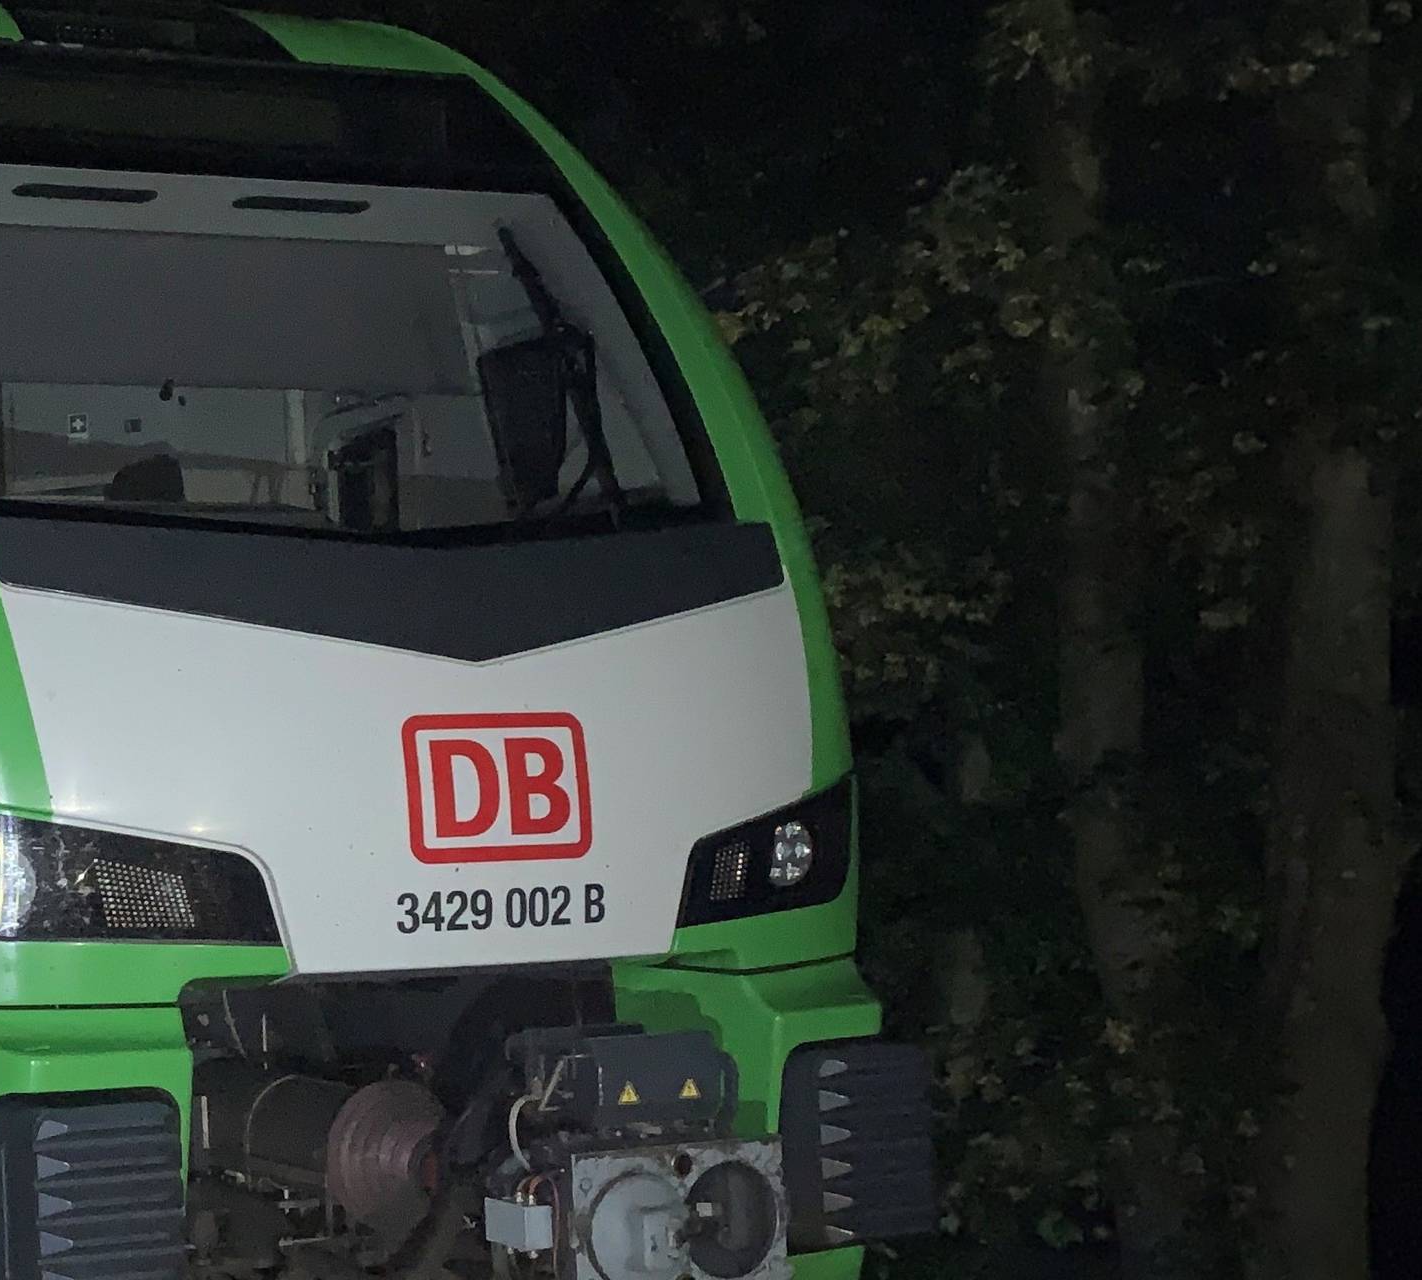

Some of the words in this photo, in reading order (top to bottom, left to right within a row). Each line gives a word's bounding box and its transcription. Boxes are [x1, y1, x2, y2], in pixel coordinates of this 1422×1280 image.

[429, 738, 571, 838] DB
[396, 889, 493, 934] 3429
[505, 885, 571, 929] 002
[584, 882, 605, 923] B
